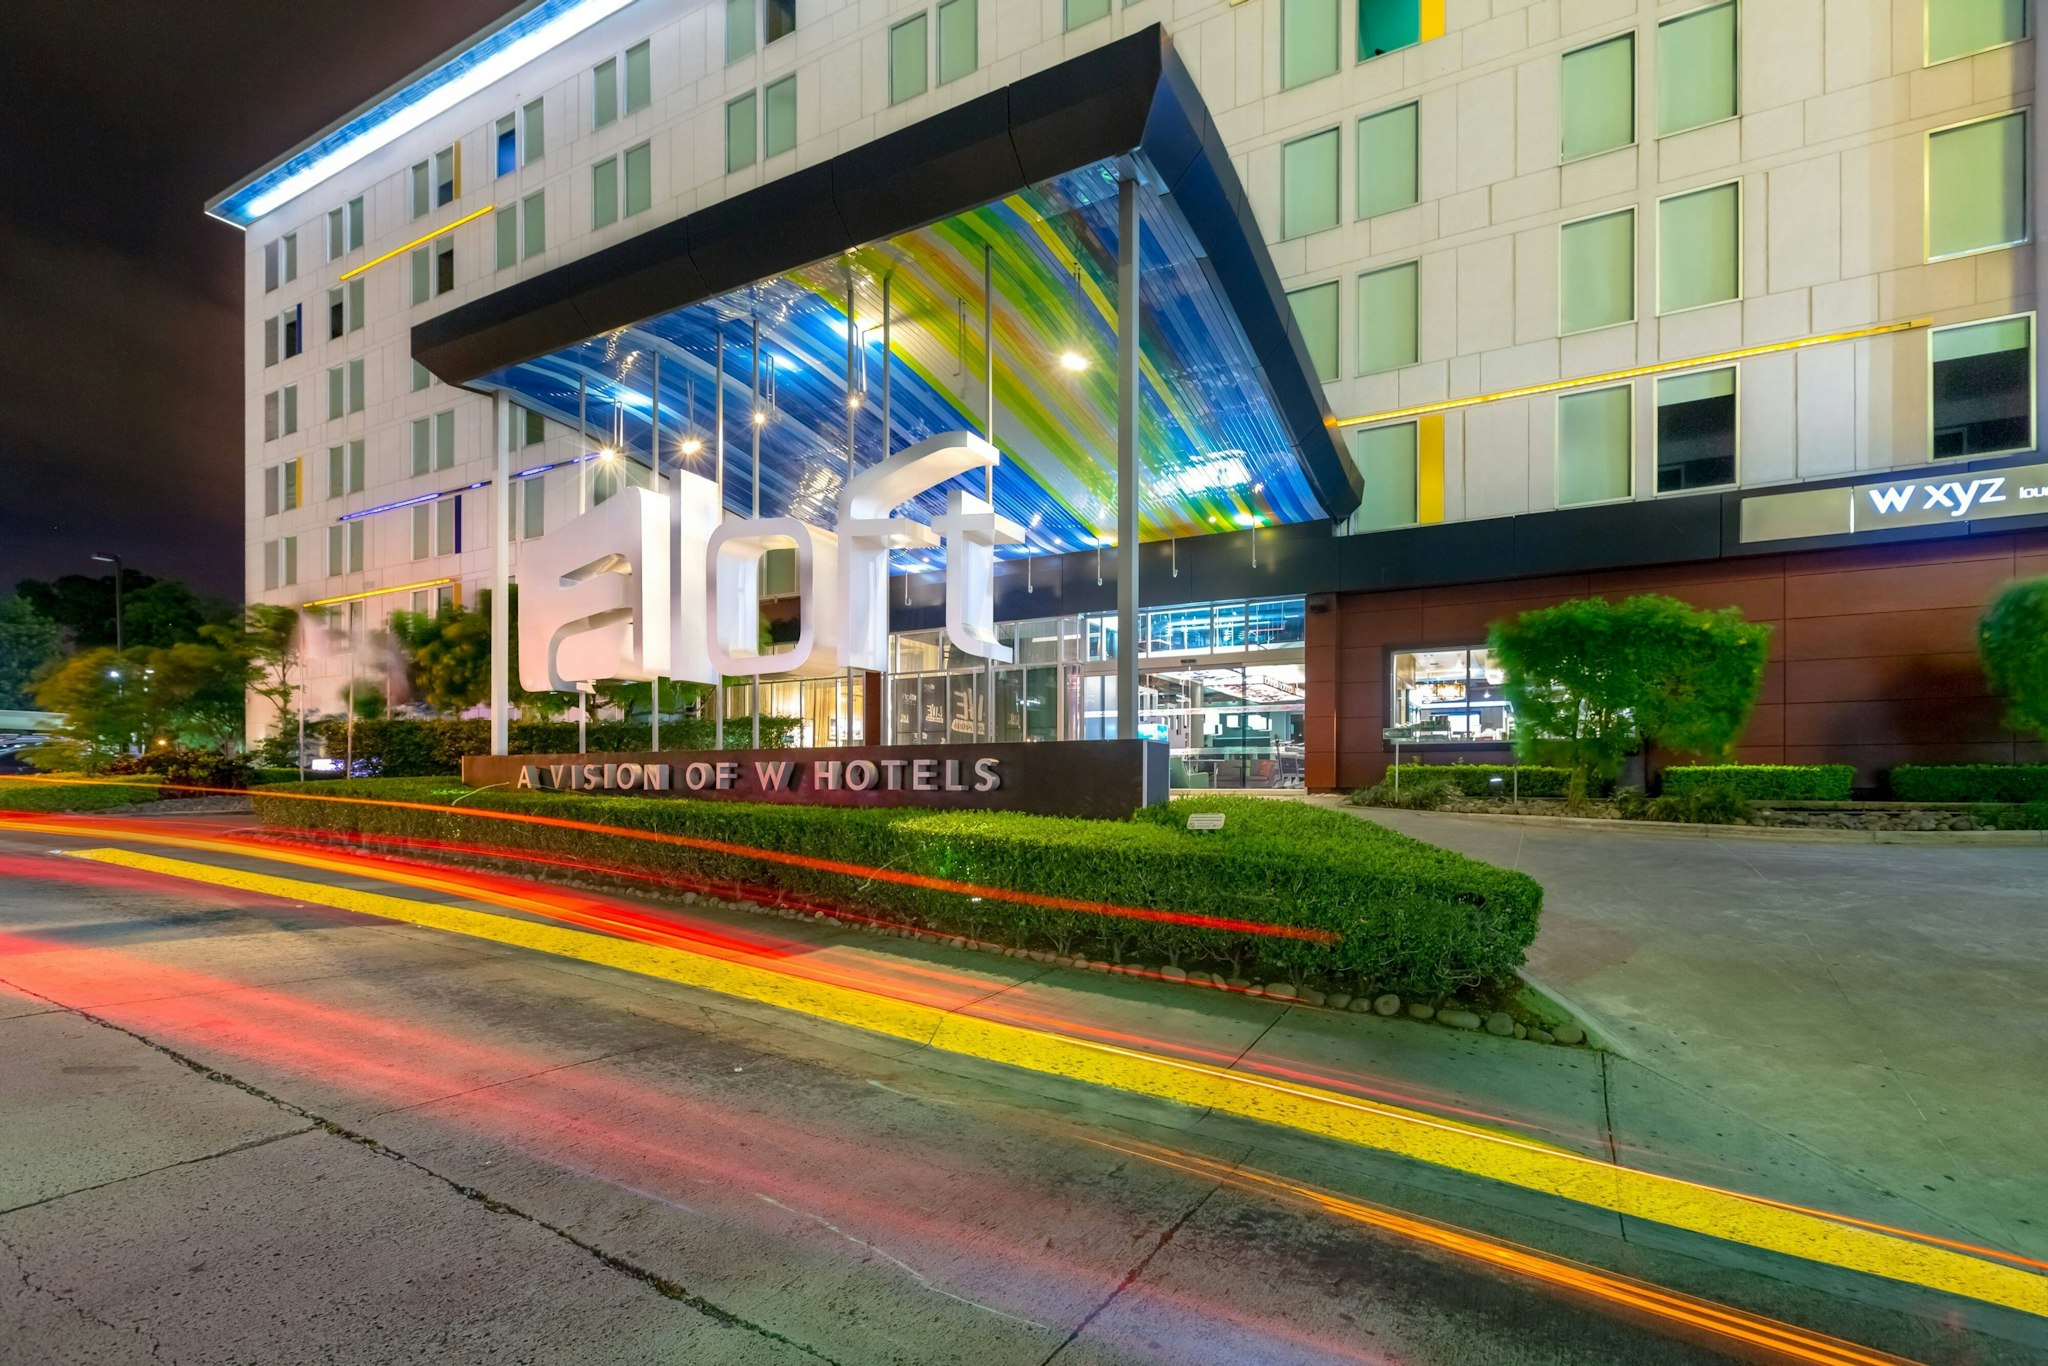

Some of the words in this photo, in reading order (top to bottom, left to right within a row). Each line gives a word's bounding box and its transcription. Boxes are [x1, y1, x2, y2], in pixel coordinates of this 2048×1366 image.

[1922, 477, 2007, 517] xyz
[518, 430, 1026, 693] aloft
[517, 764, 540, 789] A
[550, 762, 669, 790] VISION
[685, 762, 738, 790] OF
[754, 761, 794, 791] W
[814, 758, 1000, 792] HOTELS
